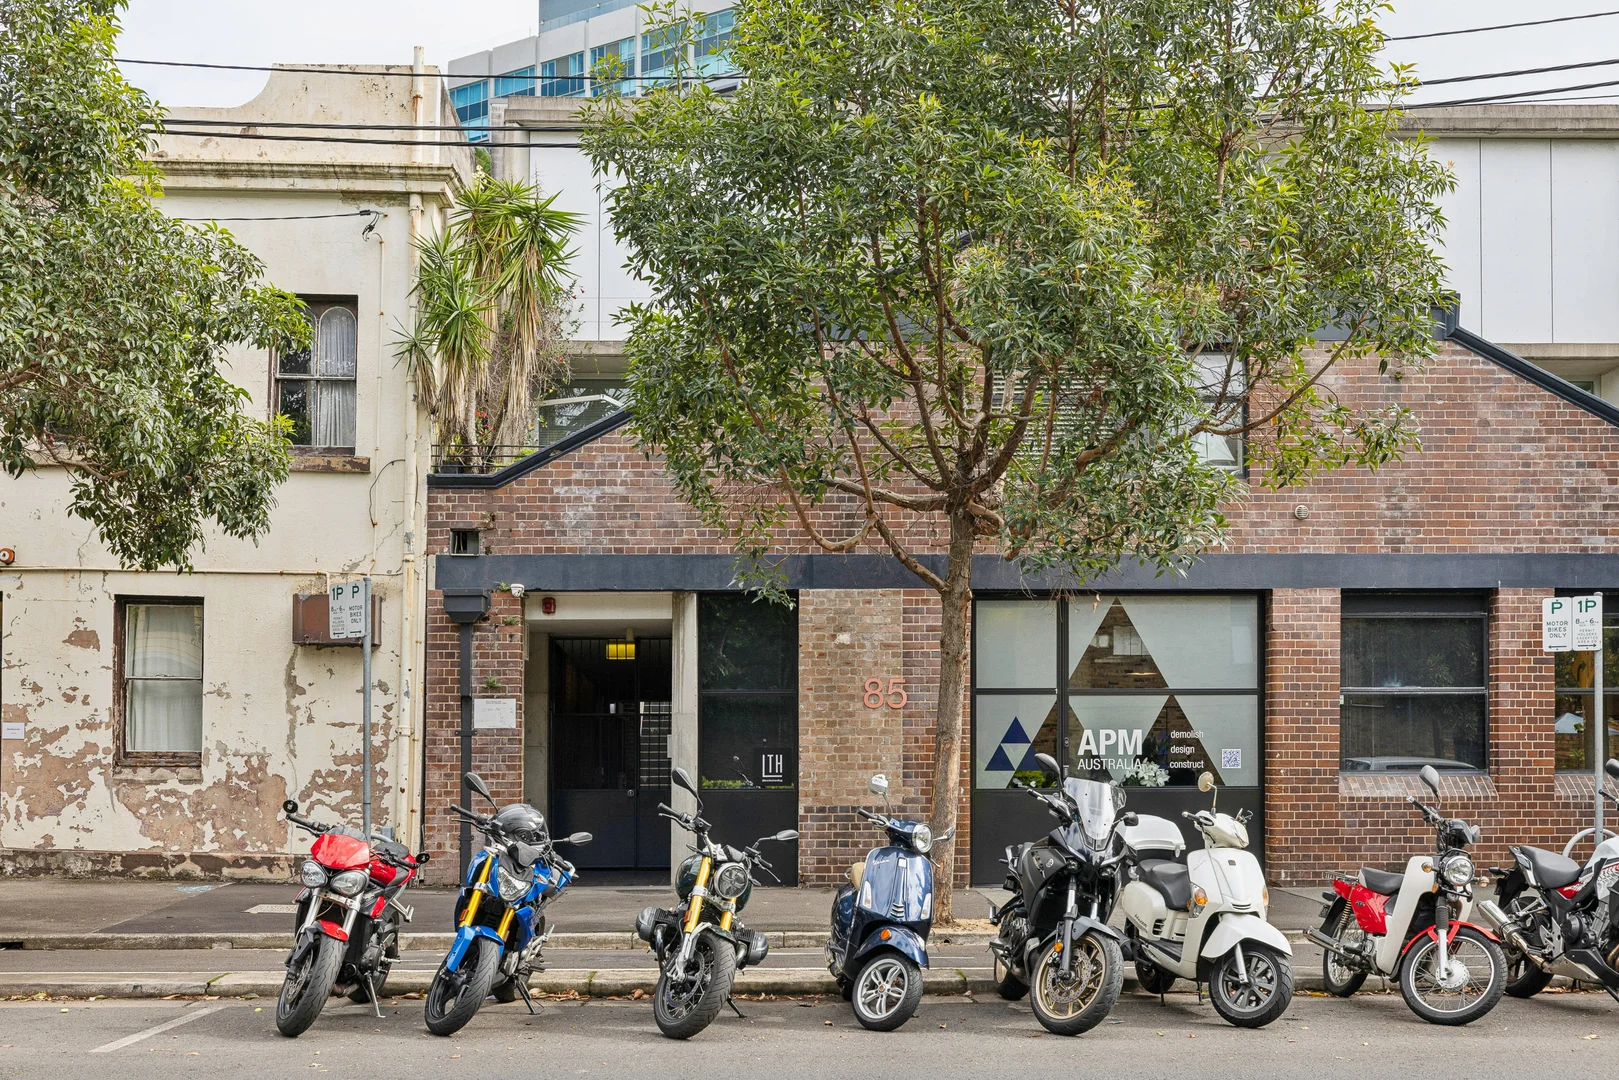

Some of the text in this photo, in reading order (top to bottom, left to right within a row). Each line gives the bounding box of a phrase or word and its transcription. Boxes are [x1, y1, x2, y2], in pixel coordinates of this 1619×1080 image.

[332, 587, 344, 600] 1P
[352, 586, 360, 598] P
[1552, 602, 1563, 614] P
[1578, 600, 1596, 612] 1P
[864, 678, 907, 709] 85
[1170, 730, 1204, 738] demolish
[1078, 728, 1142, 755] APM
[1170, 745, 1195, 754] design
[762, 754, 782, 777] LTH
[1078, 758, 1142, 770] AUSTRALIA
[1170, 760, 1204, 769] construct
